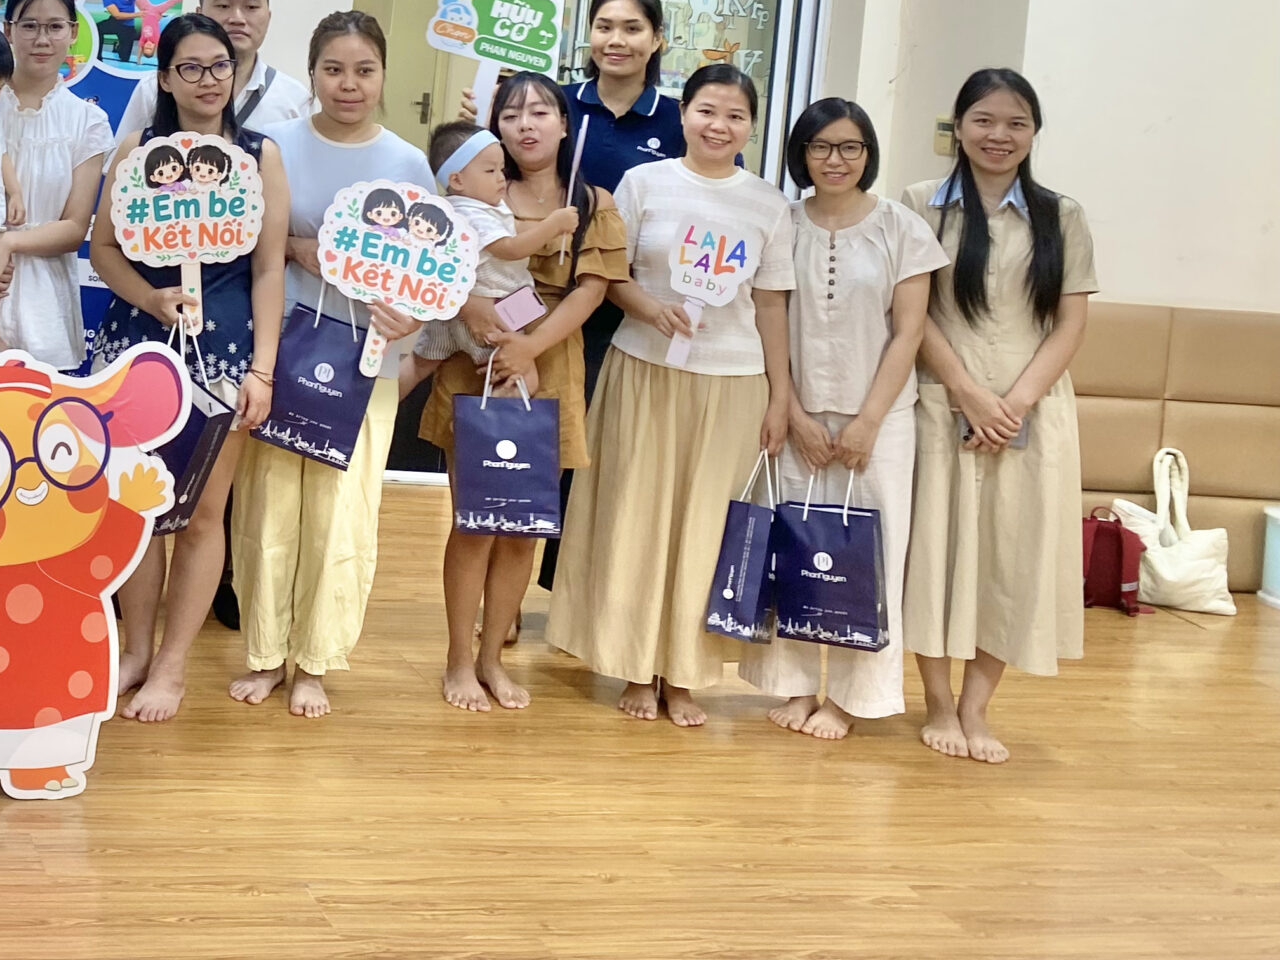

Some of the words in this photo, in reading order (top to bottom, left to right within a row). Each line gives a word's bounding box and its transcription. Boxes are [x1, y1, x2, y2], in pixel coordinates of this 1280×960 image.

[480, 42, 506, 56] PHAN
[126, 195, 201, 225] #Em
[143, 219, 192, 252] Kết
[198, 217, 245, 248] Nối
[334, 226, 411, 269] #Em
[342, 256, 394, 296] Kết
[398, 274, 449, 311] Nối
[682, 271, 726, 297] baby
